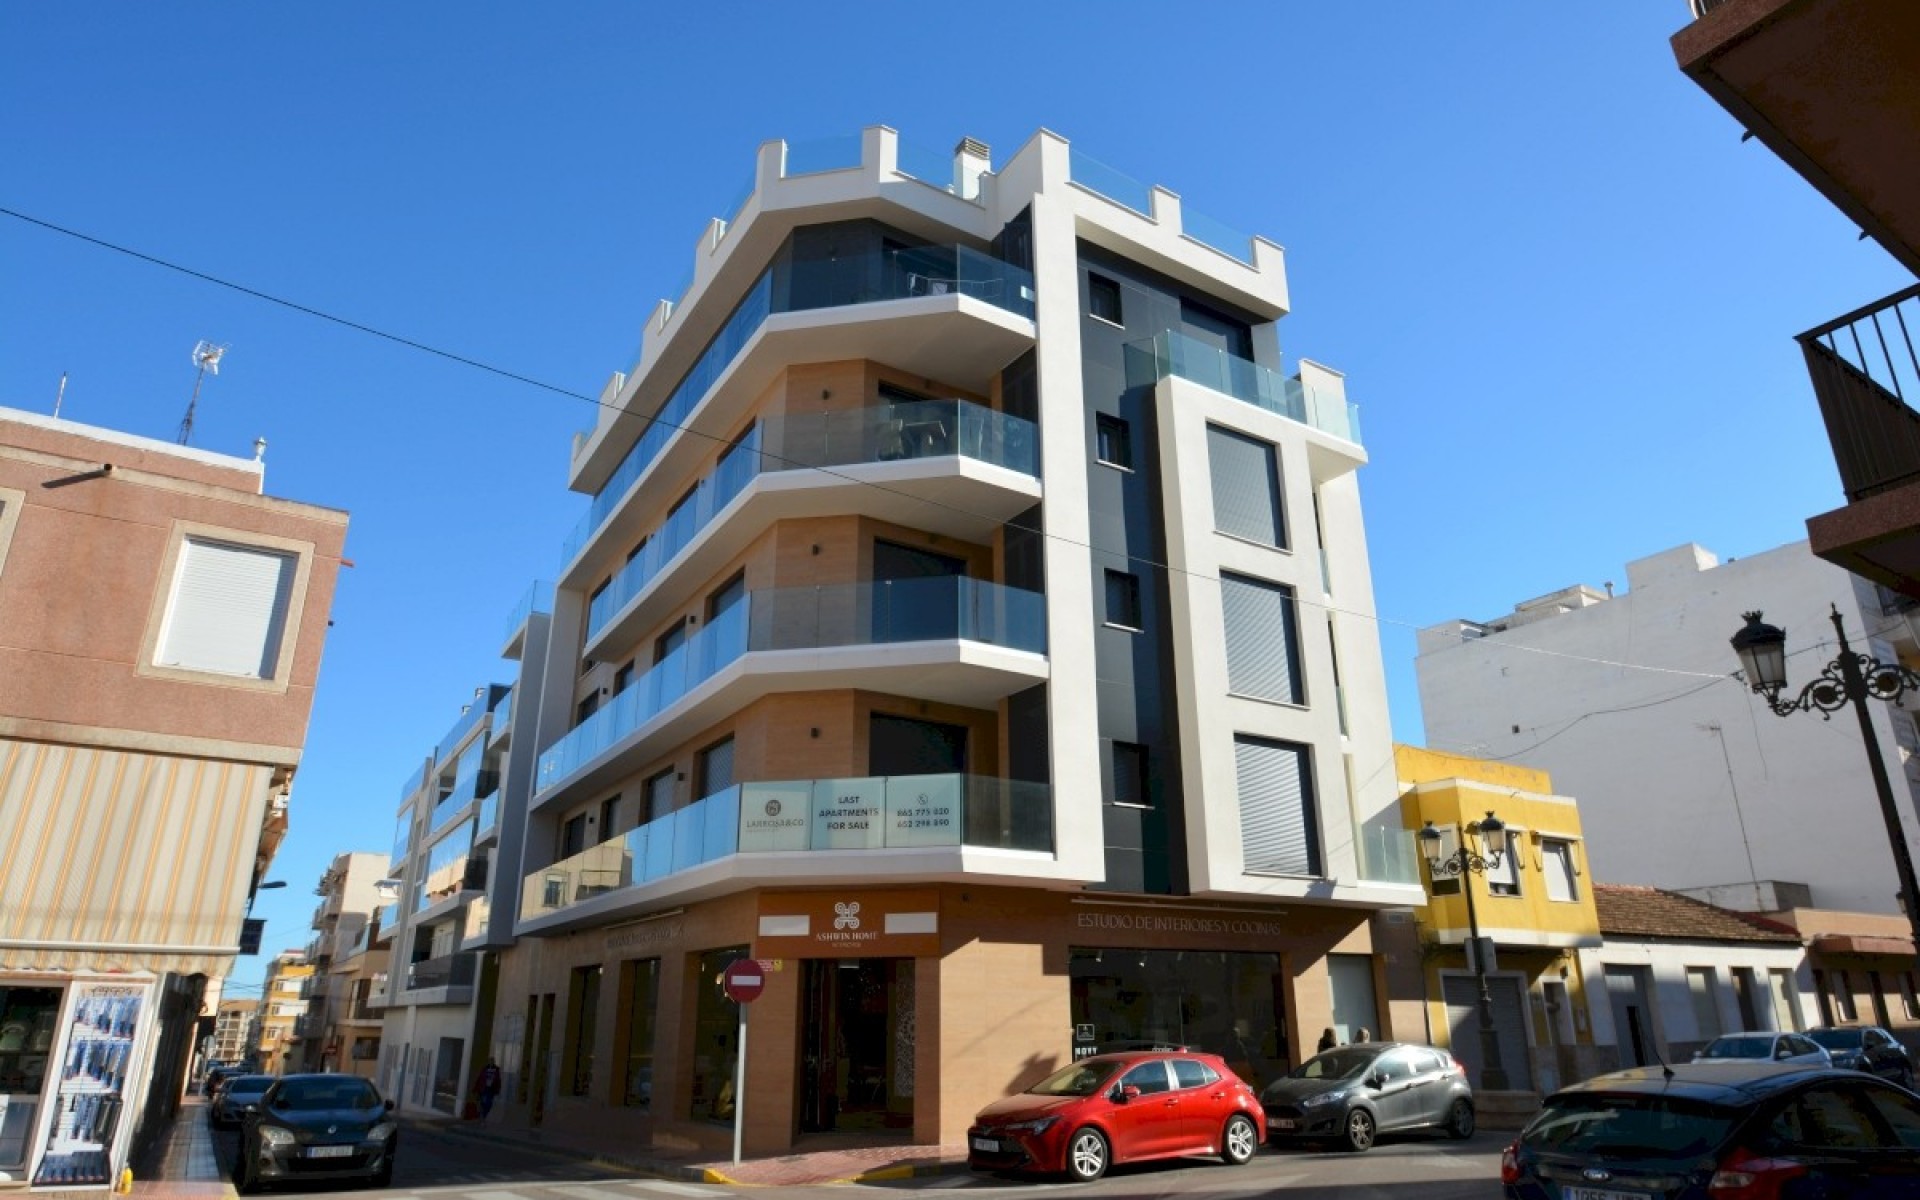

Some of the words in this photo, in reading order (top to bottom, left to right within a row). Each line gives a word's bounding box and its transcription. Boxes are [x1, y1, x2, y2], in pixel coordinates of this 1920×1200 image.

[838, 795, 860, 804] LAST
[818, 807, 879, 818] APARTMENTS
[827, 821, 846, 830] FOR
[848, 820, 870, 830] SALE
[1077, 913, 1133, 929] ESTUDIO
[1135, 916, 1153, 930] DE
[1154, 917, 1220, 933] INTERIORES
